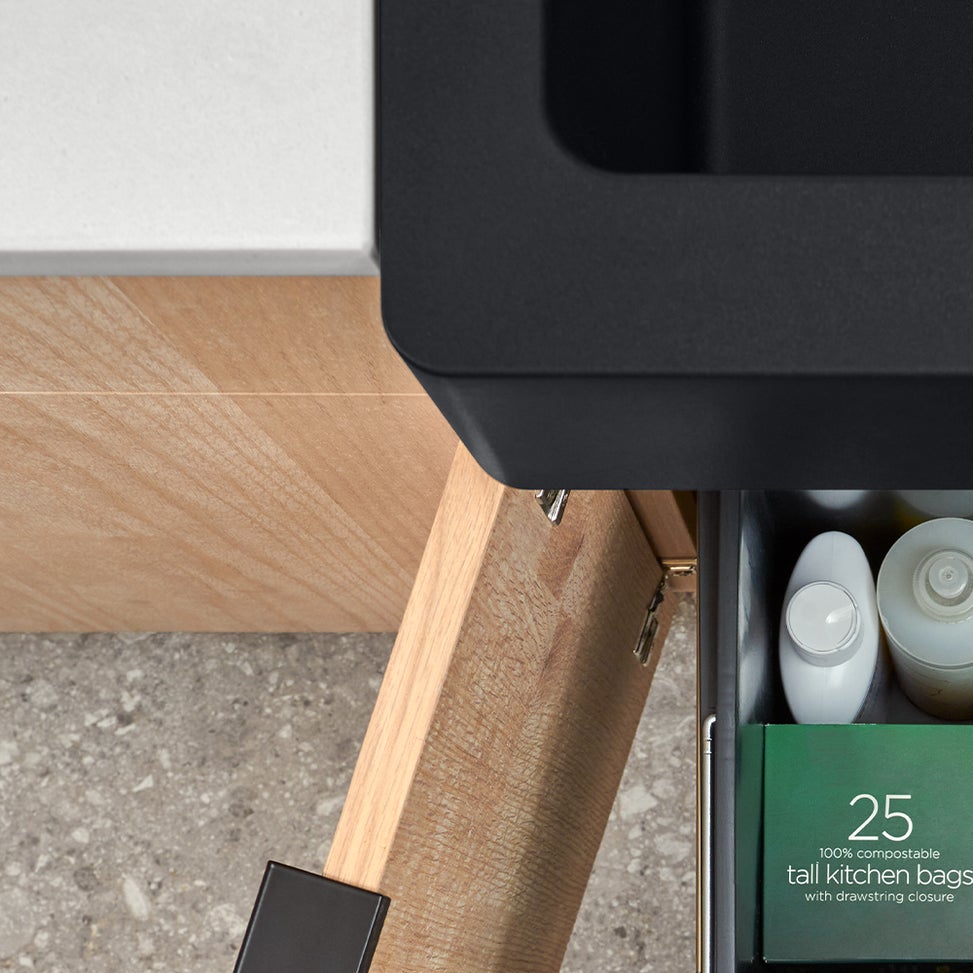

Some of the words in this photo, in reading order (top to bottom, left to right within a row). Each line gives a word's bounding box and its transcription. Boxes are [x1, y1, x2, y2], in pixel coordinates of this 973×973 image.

[848, 793, 914, 842] 25
[819, 847, 854, 859] 100%
[856, 847, 940, 861] compostable
[787, 862, 819, 885] tall
[826, 863, 910, 885] kitchen
[917, 863, 973, 889] bags
[805, 890, 832, 902] with
[836, 890, 904, 904] drawstring
[908, 891, 955, 903] closure
